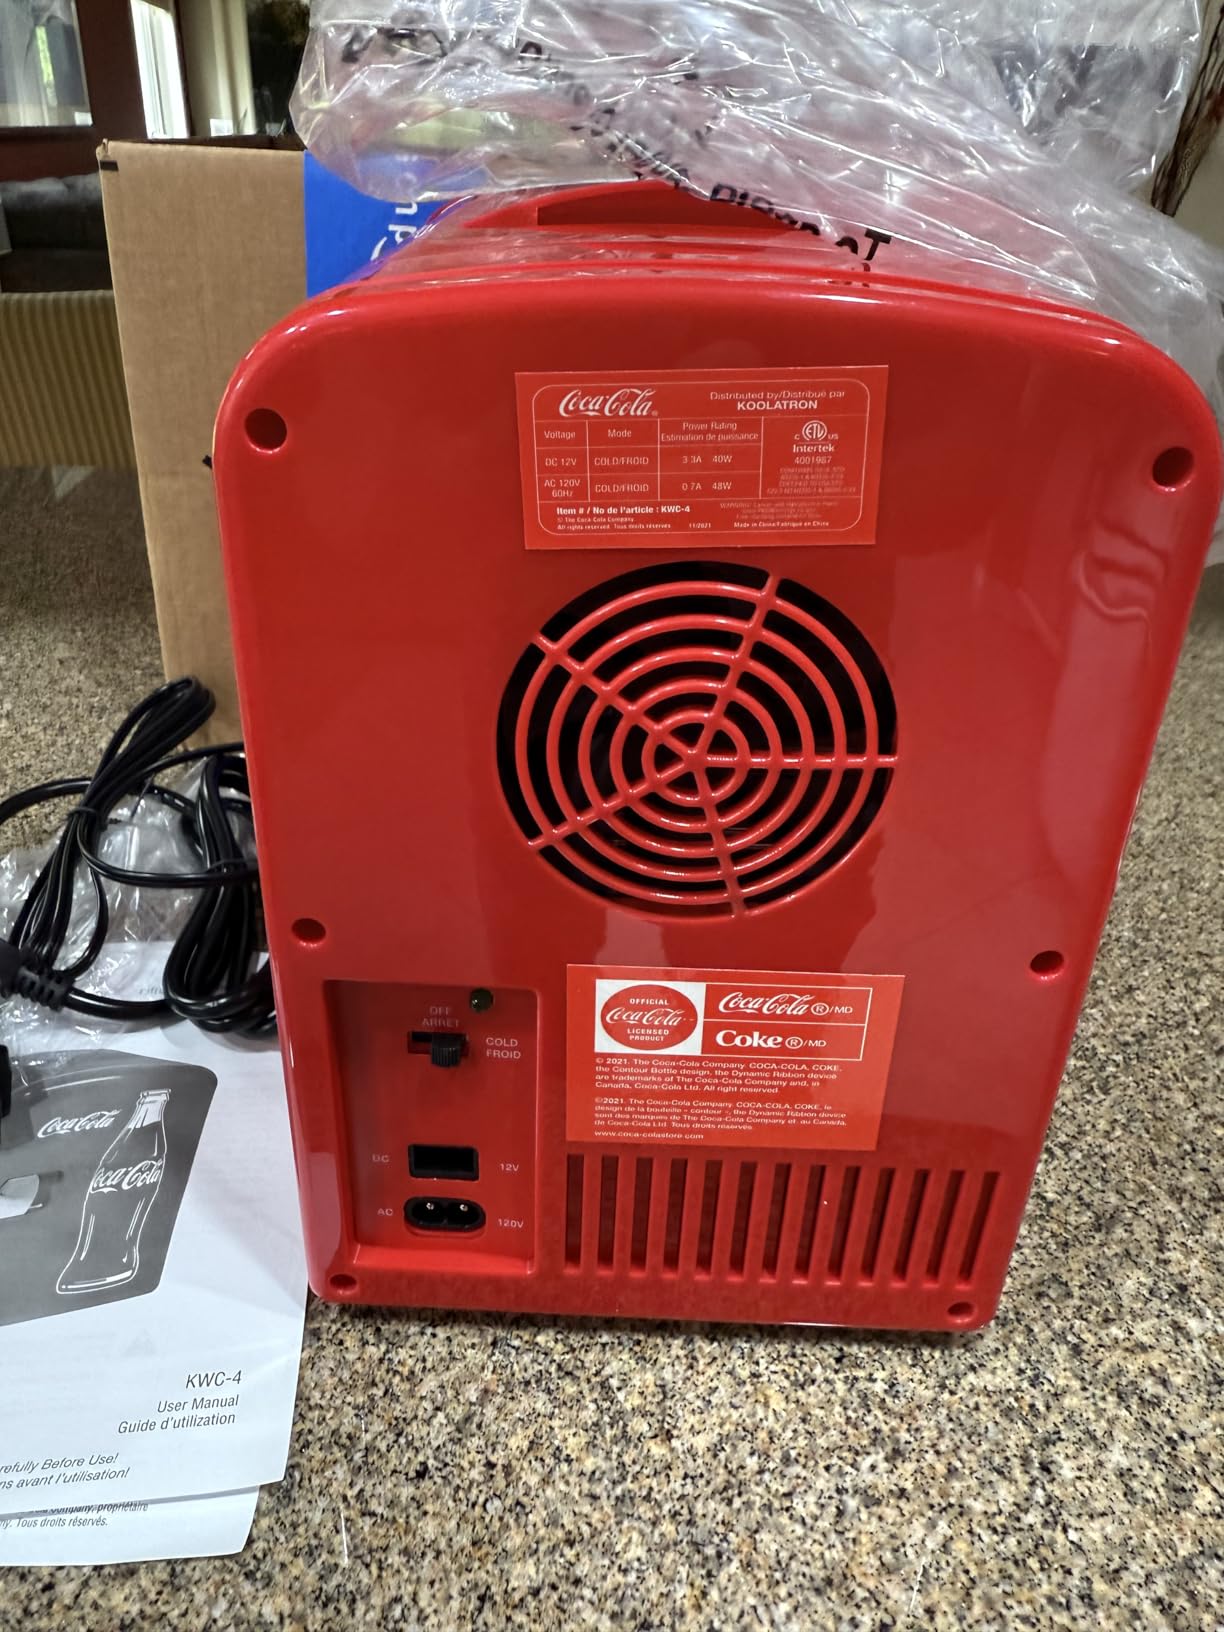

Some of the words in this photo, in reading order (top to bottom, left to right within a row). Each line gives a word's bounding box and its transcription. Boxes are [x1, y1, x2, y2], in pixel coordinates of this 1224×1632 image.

[559, 389, 656, 417] Coca-Cola
[737, 400, 817, 410] KOOLATRON
[683, 422, 708, 430] Power
[711, 422, 737, 430] Rating
[544, 431, 575, 439] Voltage
[608, 429, 631, 438] Mode
[661, 433, 703, 442] Estimation
[718, 433, 758, 441] puissance
[793, 444, 834, 452] Intertek
[545, 458, 557, 466] DC
[594, 457, 649, 465] COLD/FROID
[794, 456, 832, 464] 4001987
[559, 479, 580, 487] 120V
[595, 484, 649, 493] COLD/FROID
[552, 490, 573, 498] 60Hz
[557, 507, 576, 515] Item
[607, 506, 618, 514] de
[606, 1007, 684, 1026] Coca-Cola
[486, 1037, 518, 1047] COLD
[716, 1030, 782, 1048] Coke
[486, 1050, 521, 1059] FROID
[652, 1059, 700, 1067] Coca-Cola
[732, 1070, 770, 1078] Dynamic
[694, 1076, 743, 1085] Coca-Cola
[745, 1078, 786, 1087] Company
[595, 1105, 622, 1113] design
[749, 1109, 784, 1117] Dynamic
[787, 1110, 816, 1118] Ribbon
[37, 1109, 123, 1138] Coca-Cola
[746, 1117, 784, 1125] Company
[372, 1154, 389, 1163] DC
[500, 1163, 519, 1172] 12V
[377, 1208, 393, 1216] AC
[498, 1219, 523, 1228] 120V
[186, 1370, 242, 1389] KWC-4
[158, 1400, 188, 1413] User
[191, 1394, 239, 1410] Manual
[118, 1420, 156, 1434] Guide
[160, 1412, 235, 1430] d'utilization
[41, 1458, 85, 1470] Before
[89, 1453, 119, 1465] Use!
[16, 1475, 53, 1488] avant
[55, 1467, 130, 1484] l'utilisation!
[17, 1518, 38, 1527] Tous
[40, 1517, 66, 1527] droits
[68, 1516, 108, 1527] réservés.
